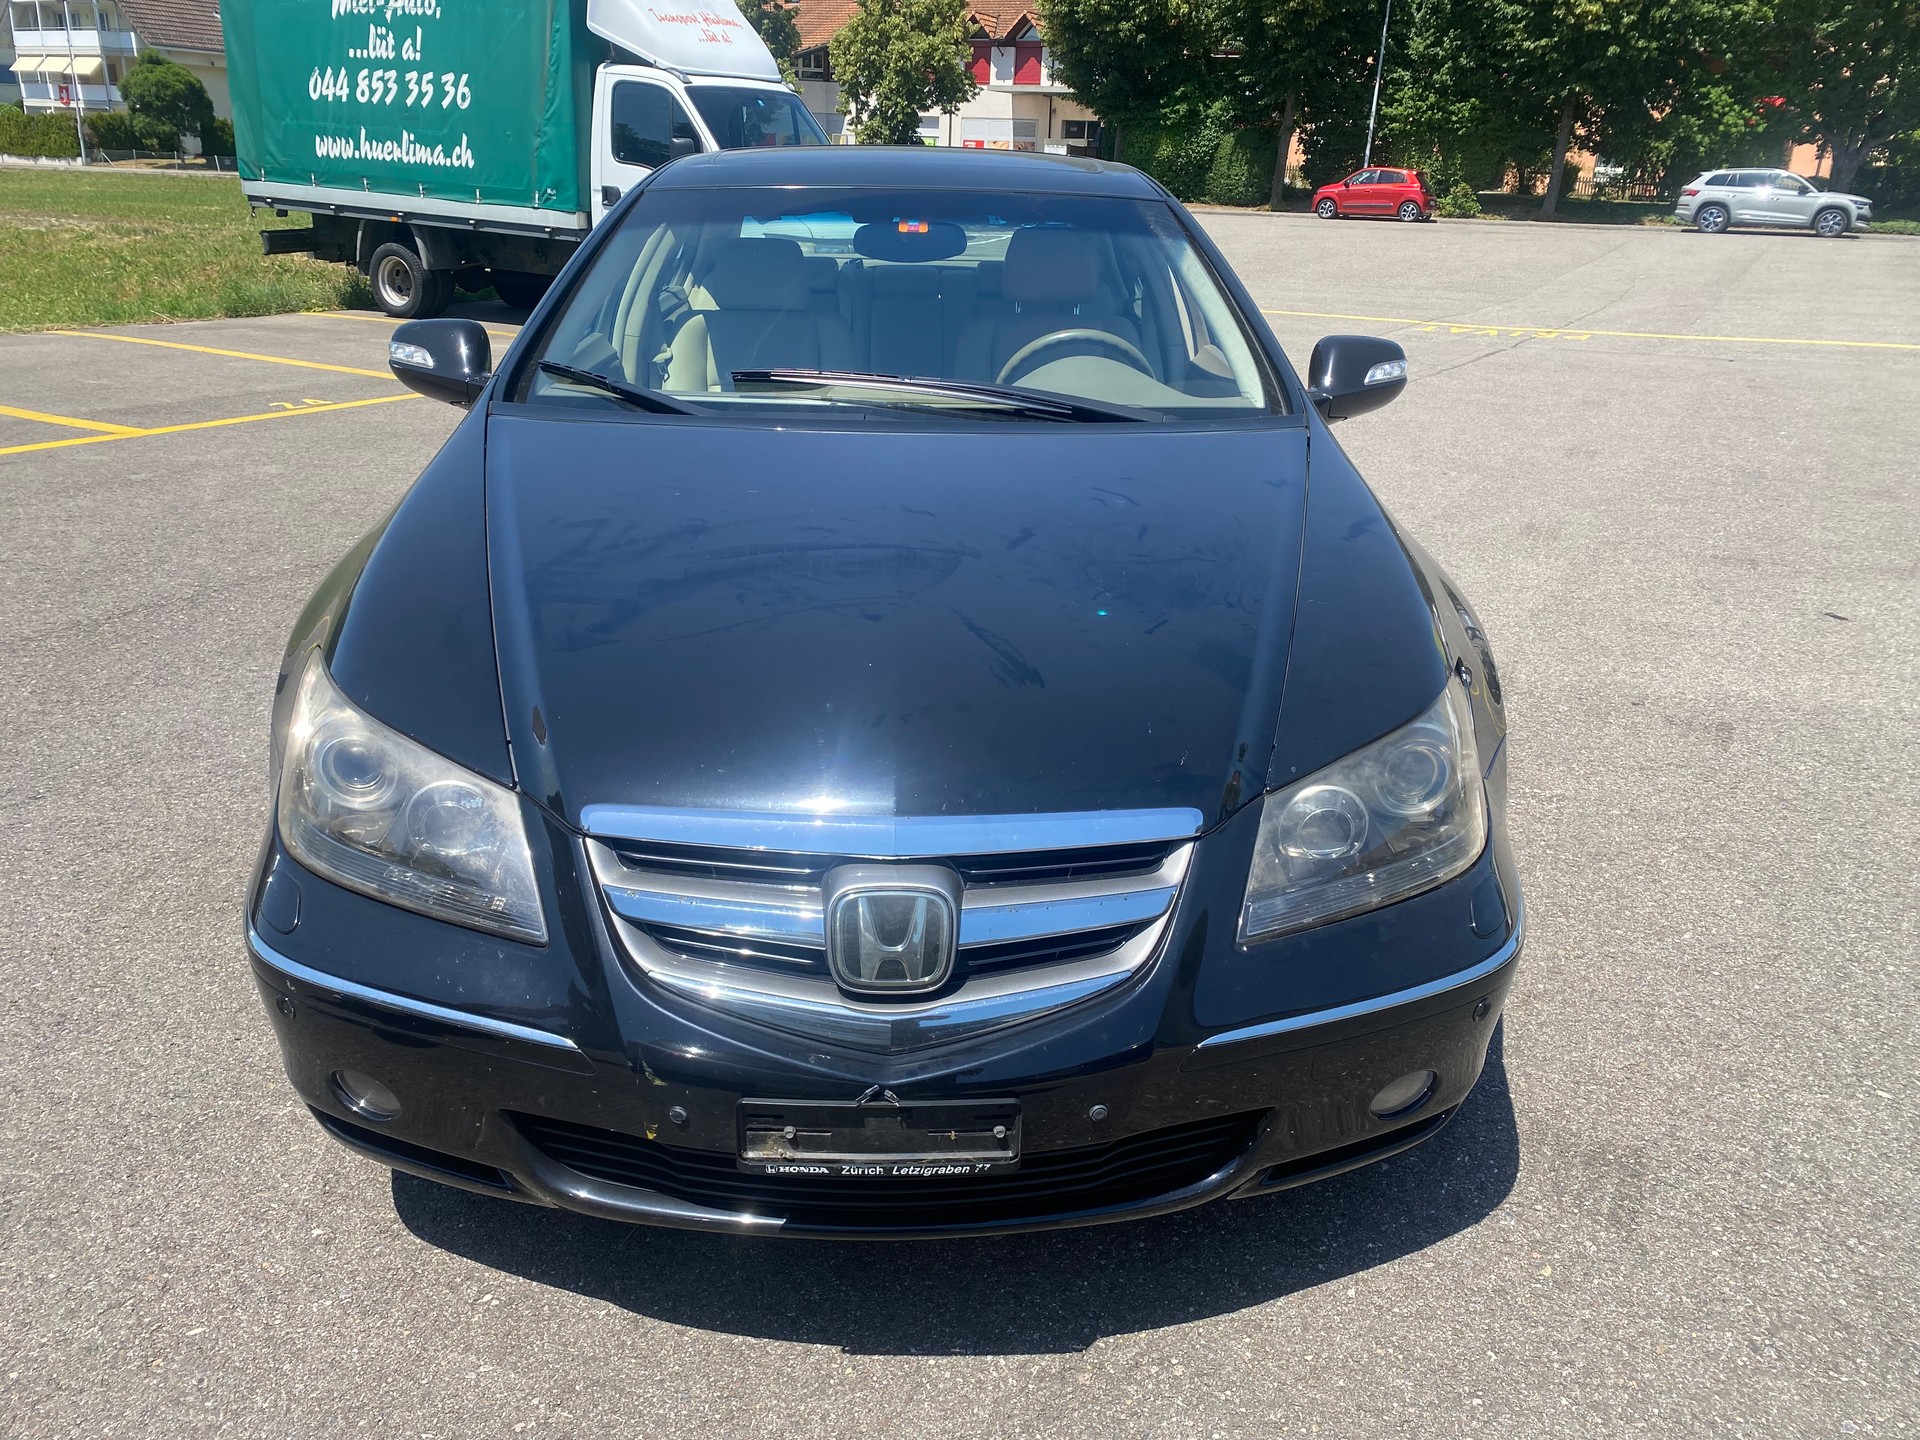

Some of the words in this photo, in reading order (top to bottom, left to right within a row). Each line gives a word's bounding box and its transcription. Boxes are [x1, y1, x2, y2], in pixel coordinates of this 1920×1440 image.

[402, 25, 422, 61] a!
[308, 65, 349, 102] 044
[356, 68, 398, 106] 853
[405, 70, 434, 108] 35
[441, 72, 472, 110] 36
[315, 125, 475, 169] www.huerlima.ch
[779, 1166, 830, 1174] HONDA
[841, 1165, 884, 1175] Zürich
[892, 1164, 970, 1176] Letzigraben
